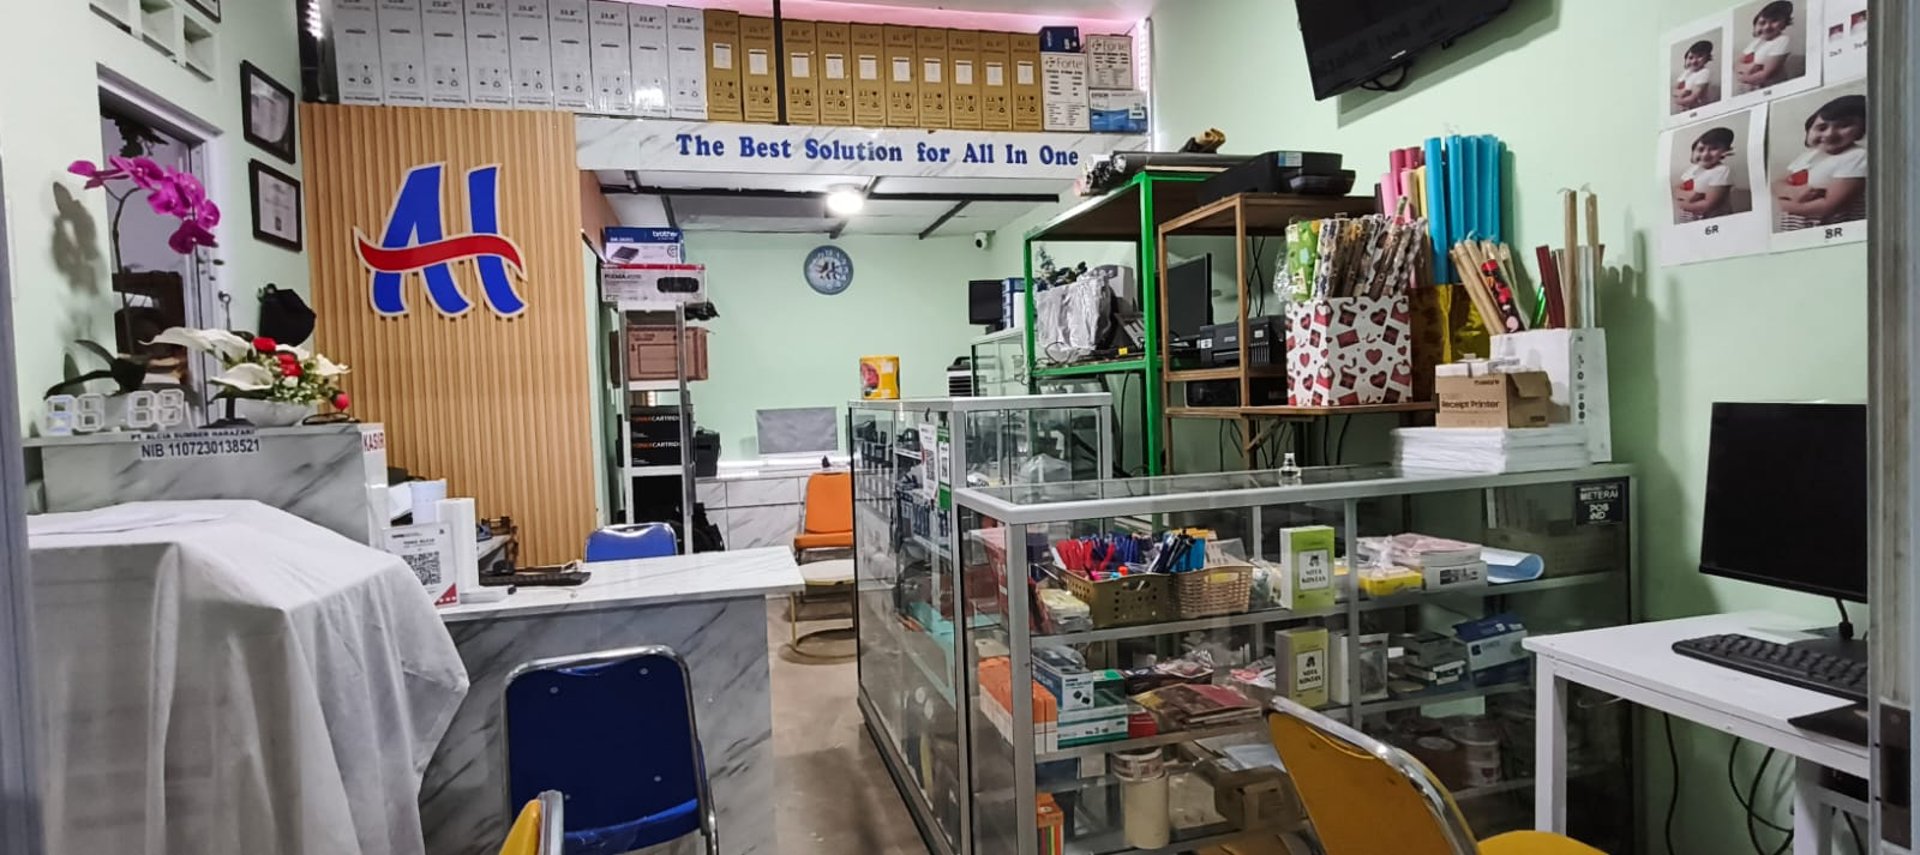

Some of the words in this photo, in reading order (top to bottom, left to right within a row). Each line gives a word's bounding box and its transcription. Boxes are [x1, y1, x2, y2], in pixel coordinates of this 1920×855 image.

[676, 134, 724, 156] The
[739, 136, 791, 158] Best
[805, 138, 902, 161] Solution
[917, 142, 950, 162] for
[962, 143, 994, 164] All
[1006, 144, 1027, 164] In
[1040, 145, 1079, 165] One
[1704, 224, 1719, 236] 6R
[1441, 401, 1469, 409] Receipt
[1470, 400, 1500, 408] Printer
[141, 443, 165, 458] NIB
[169, 438, 260, 456] 1107230138521
[363, 432, 385, 452] KASIR
[1580, 489, 1619, 501] METERAI
[1589, 503, 1610, 512] POS
[1301, 575, 1326, 584] KONTAN
